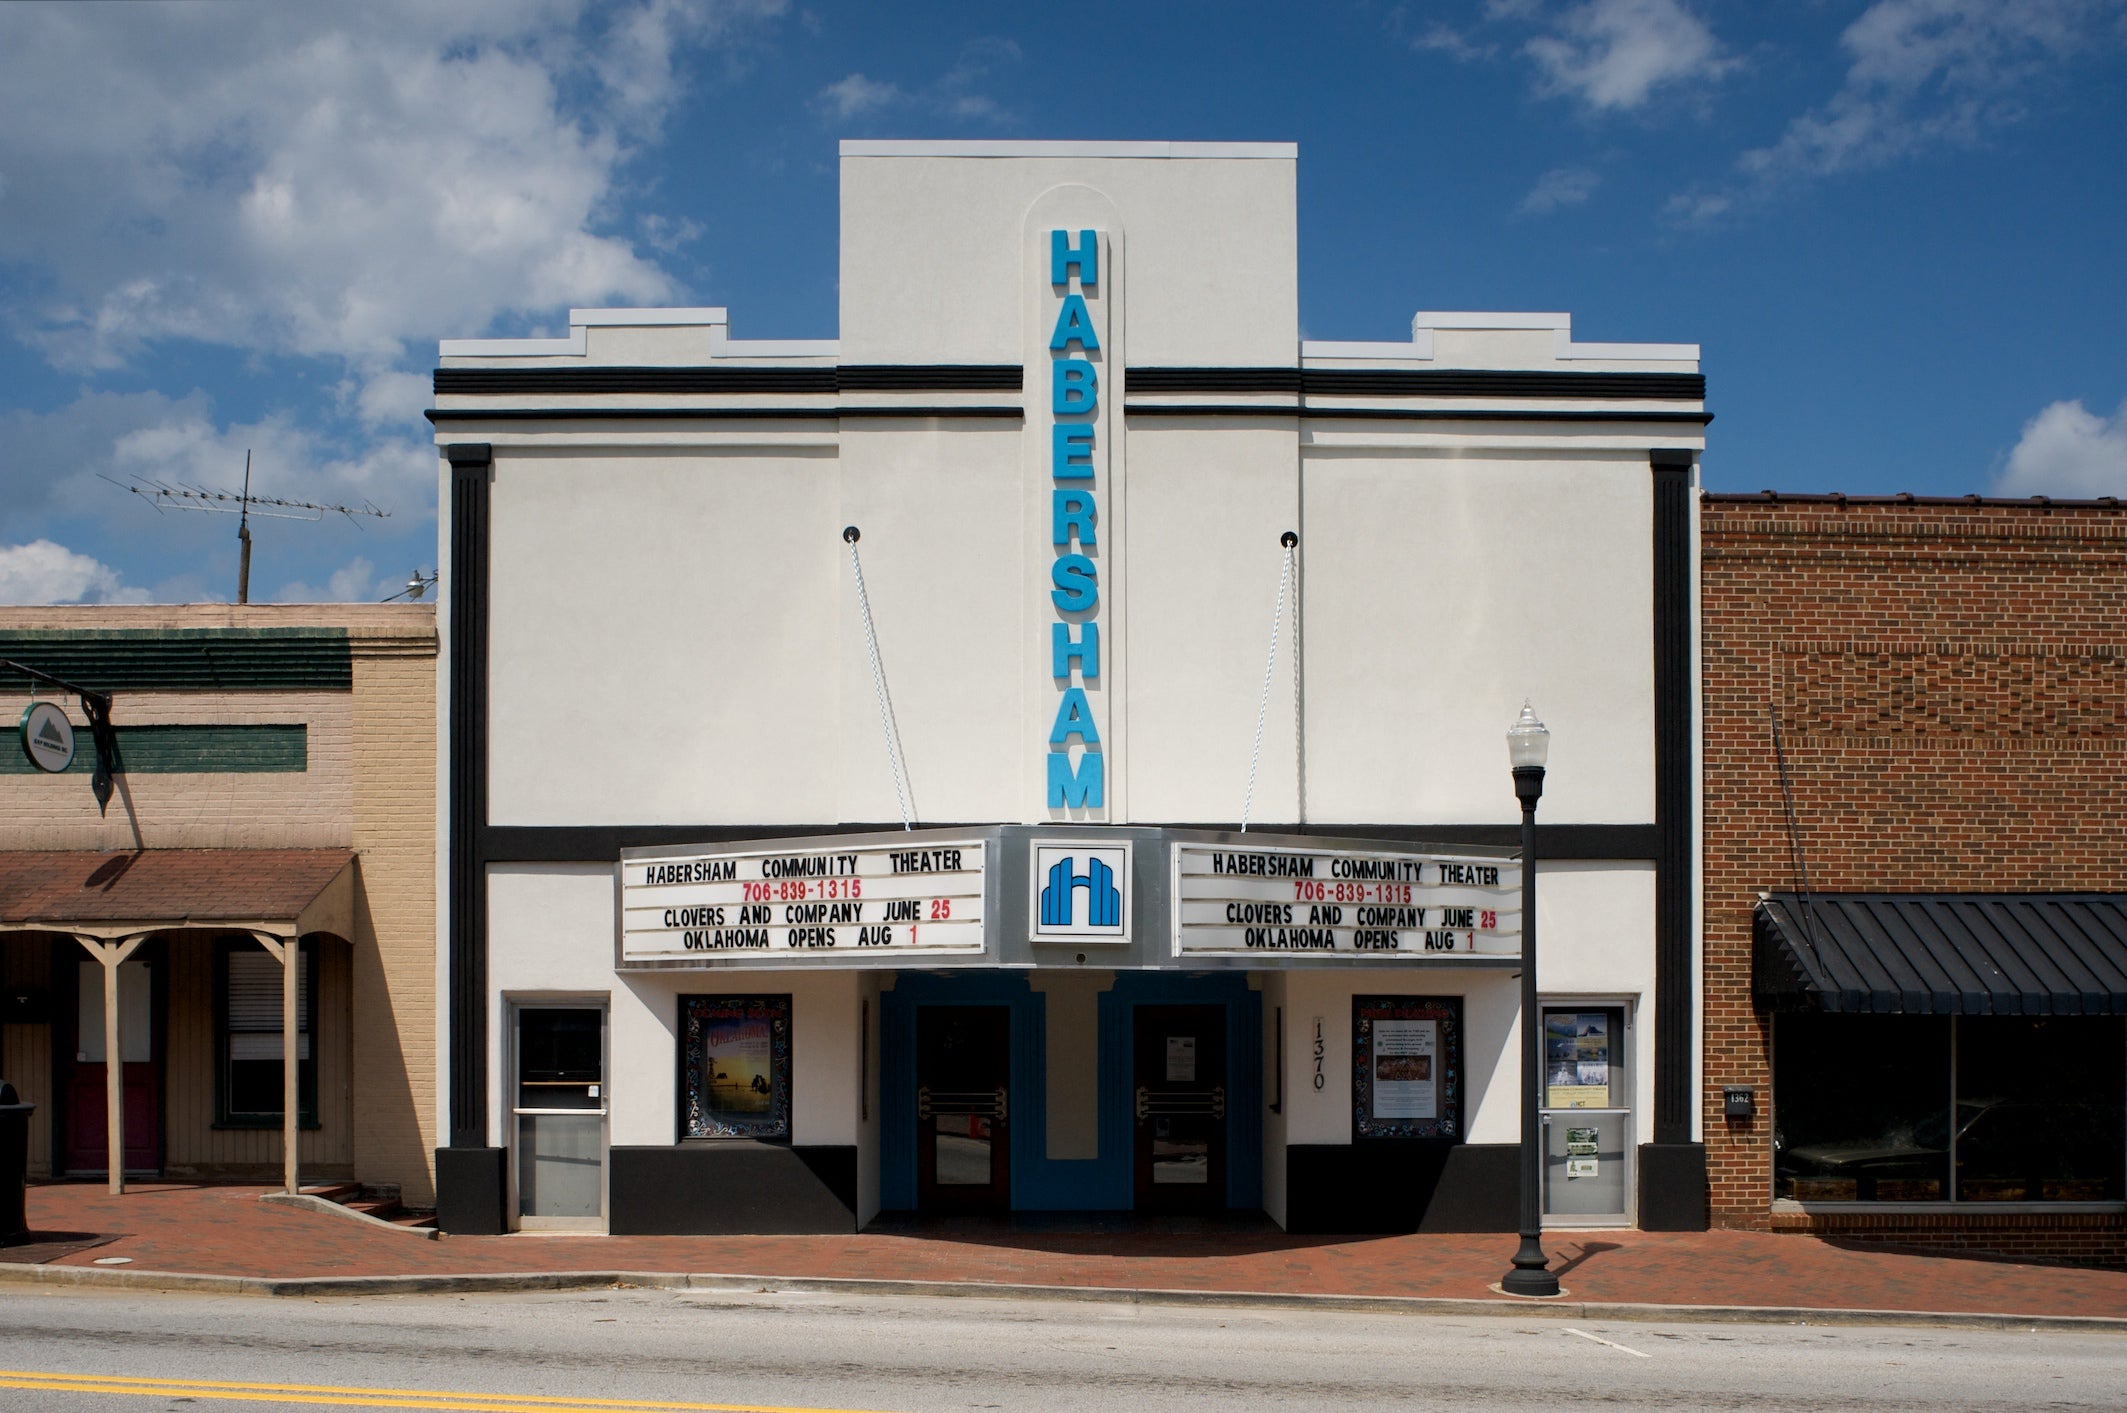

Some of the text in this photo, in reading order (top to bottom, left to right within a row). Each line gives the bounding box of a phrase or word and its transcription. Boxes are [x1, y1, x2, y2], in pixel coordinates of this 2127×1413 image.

[1047, 229, 1104, 809] HABERSHAM
[646, 850, 962, 884] HABERSHAM COMMUNITY THEATER
[1213, 853, 1499, 885] HABERSHAM COMMUNITY THEATER
[743, 879, 861, 901] 706-839-1315
[1294, 881, 1411, 904] 706-839-1315
[664, 899, 951, 927] CLOVERS AND COMPANY JUNE 25
[1226, 903, 1496, 929] CLOVERS AND COMPANY JUNE 25
[683, 925, 918, 950] OKLAHOMA OPENS AUG 1
[1245, 928, 1474, 950] OKLAHOMA OPENS AUG 1
[1314, 1022, 1325, 1090] 1370
[1731, 1093, 1749, 1103] 1362
